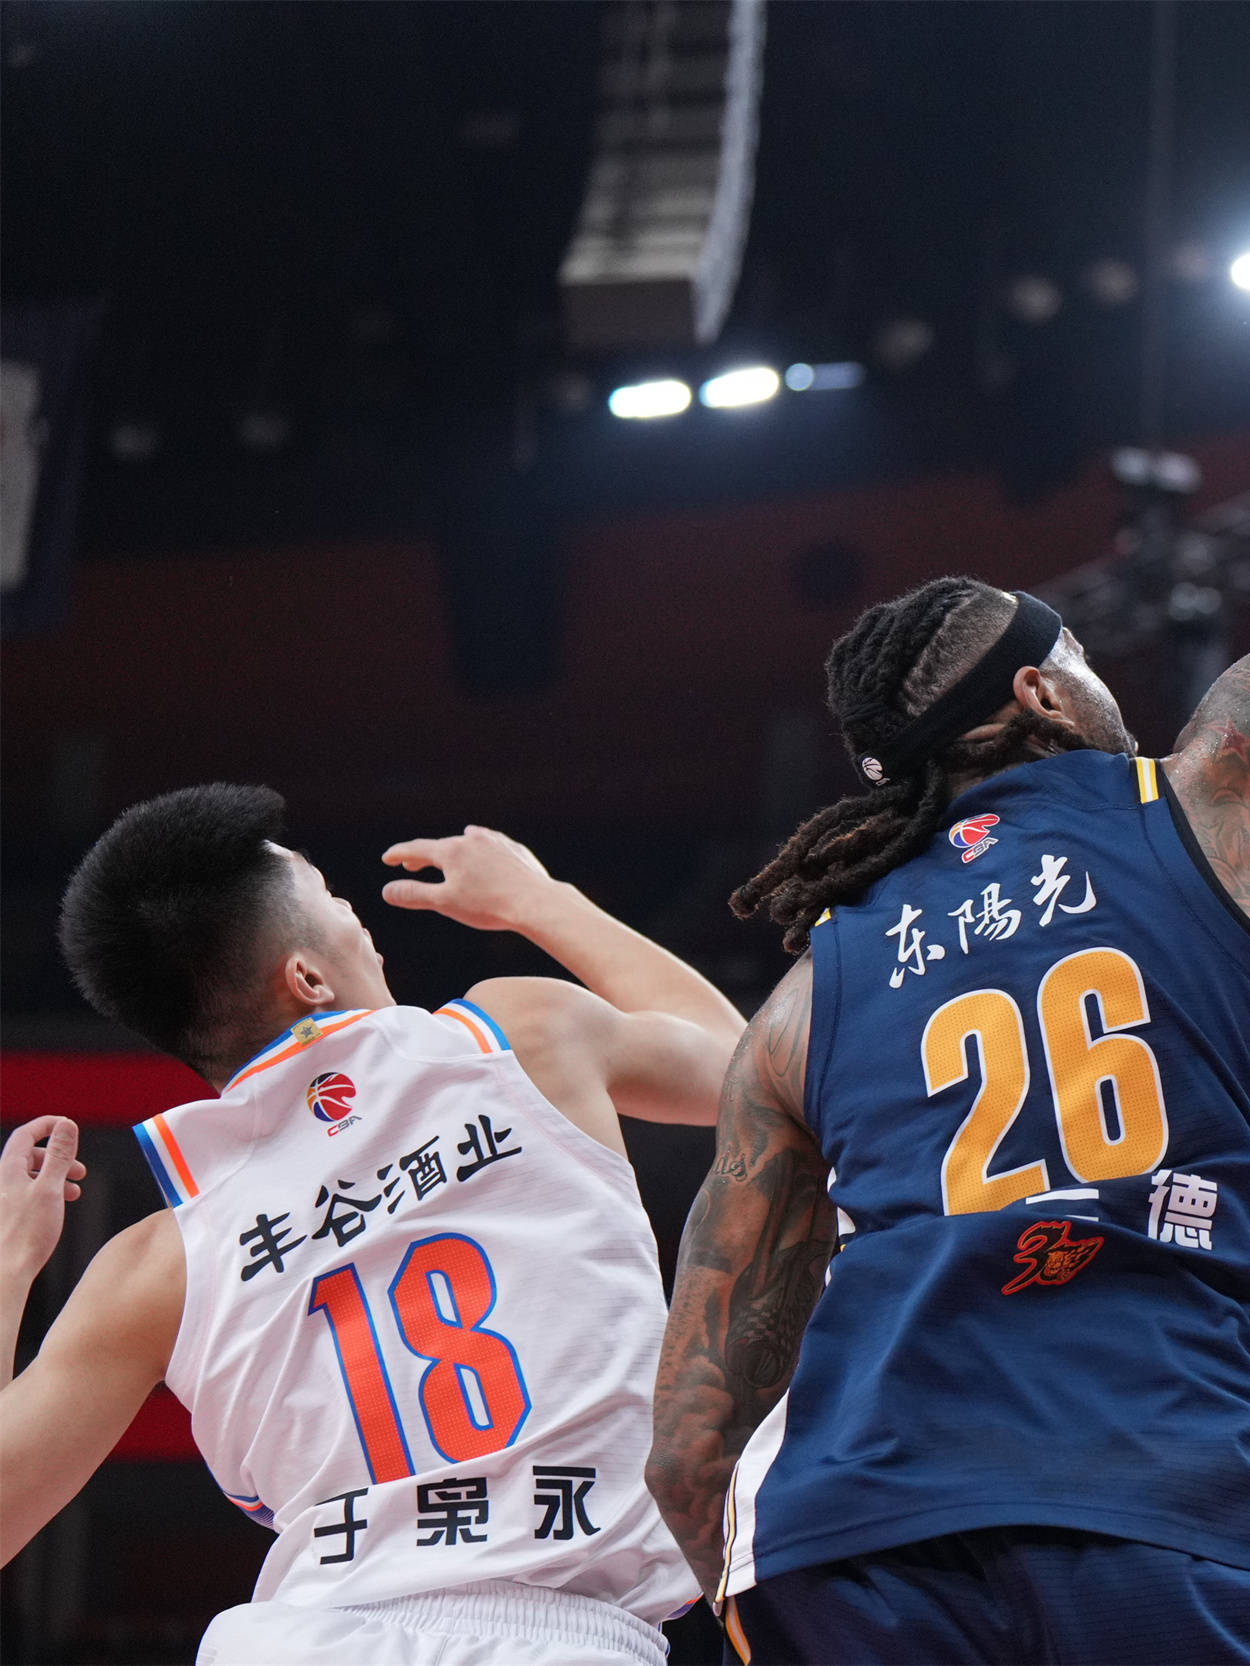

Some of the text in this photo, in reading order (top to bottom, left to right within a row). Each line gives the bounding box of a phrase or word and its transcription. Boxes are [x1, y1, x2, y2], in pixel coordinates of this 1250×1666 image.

[961, 837, 999, 864] CBA
[327, 1115, 362, 1137] CBA
[921, 946, 1169, 1216] 26
[239, 1114, 522, 1281] 丰谷酒业
[307, 1232, 532, 1486] 18
